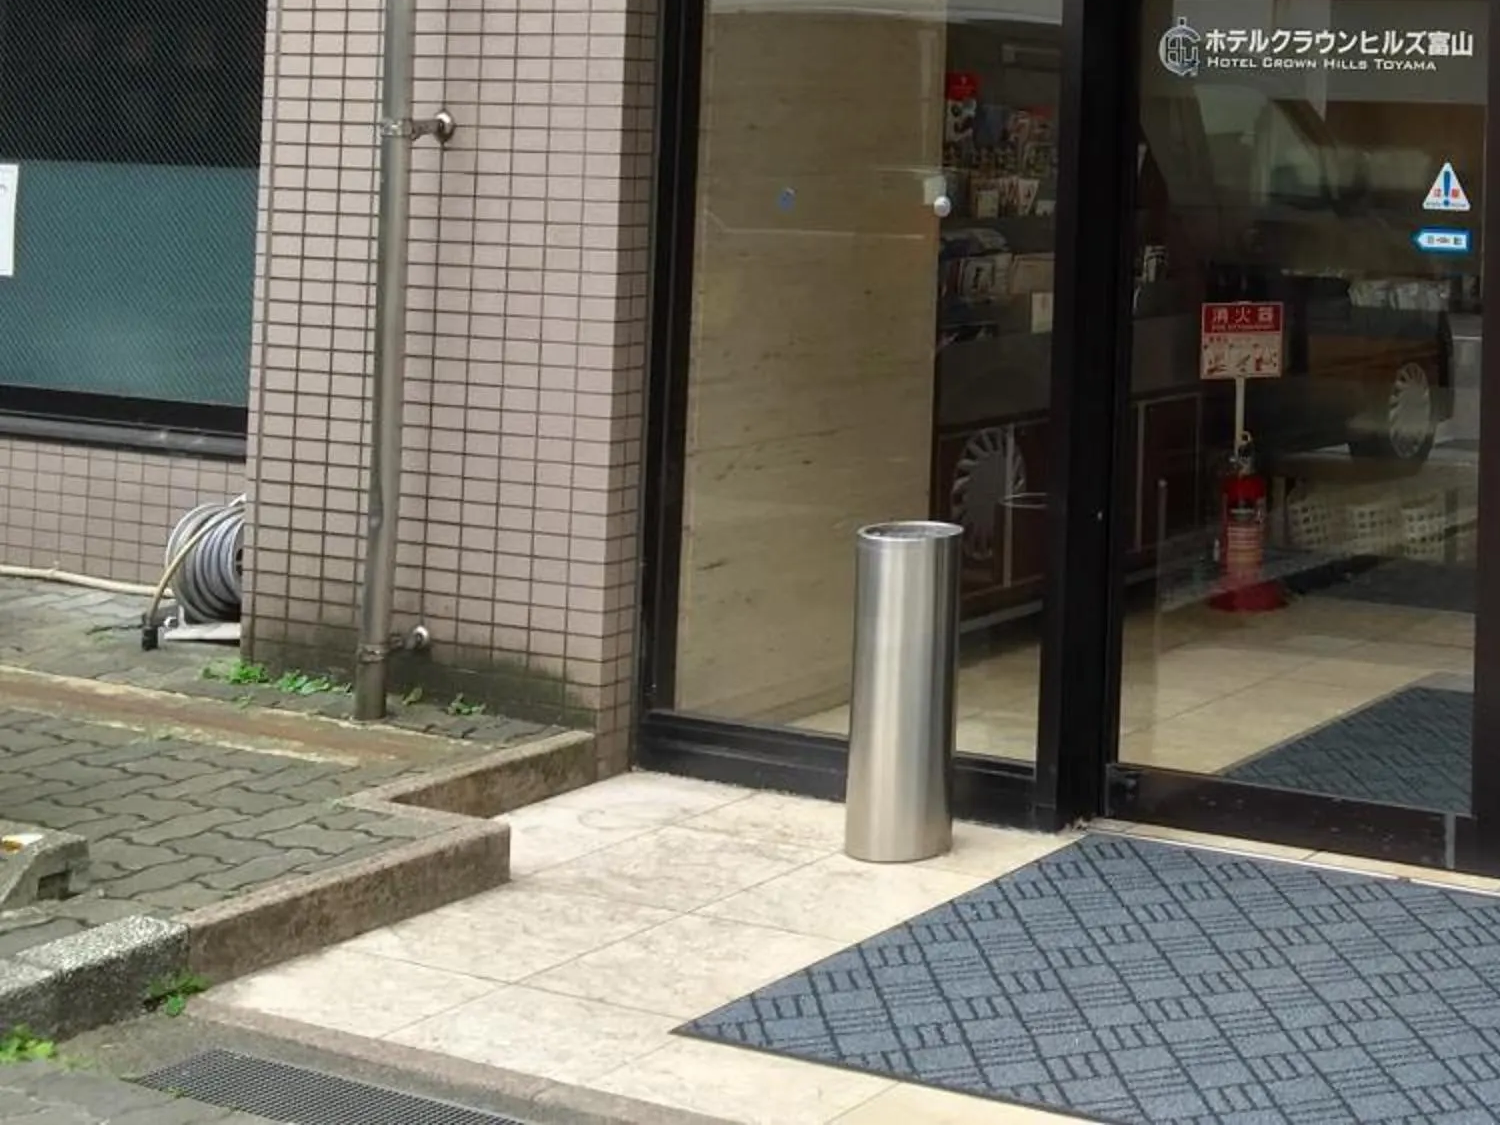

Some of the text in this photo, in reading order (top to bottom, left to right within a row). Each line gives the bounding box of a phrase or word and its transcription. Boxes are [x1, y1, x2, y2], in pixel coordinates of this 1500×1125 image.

[1206, 29, 1474, 57] ホテルクラウンヒルズ富山
[1208, 56, 1436, 71] HOTEL CROWN HILLS TOYAMA
